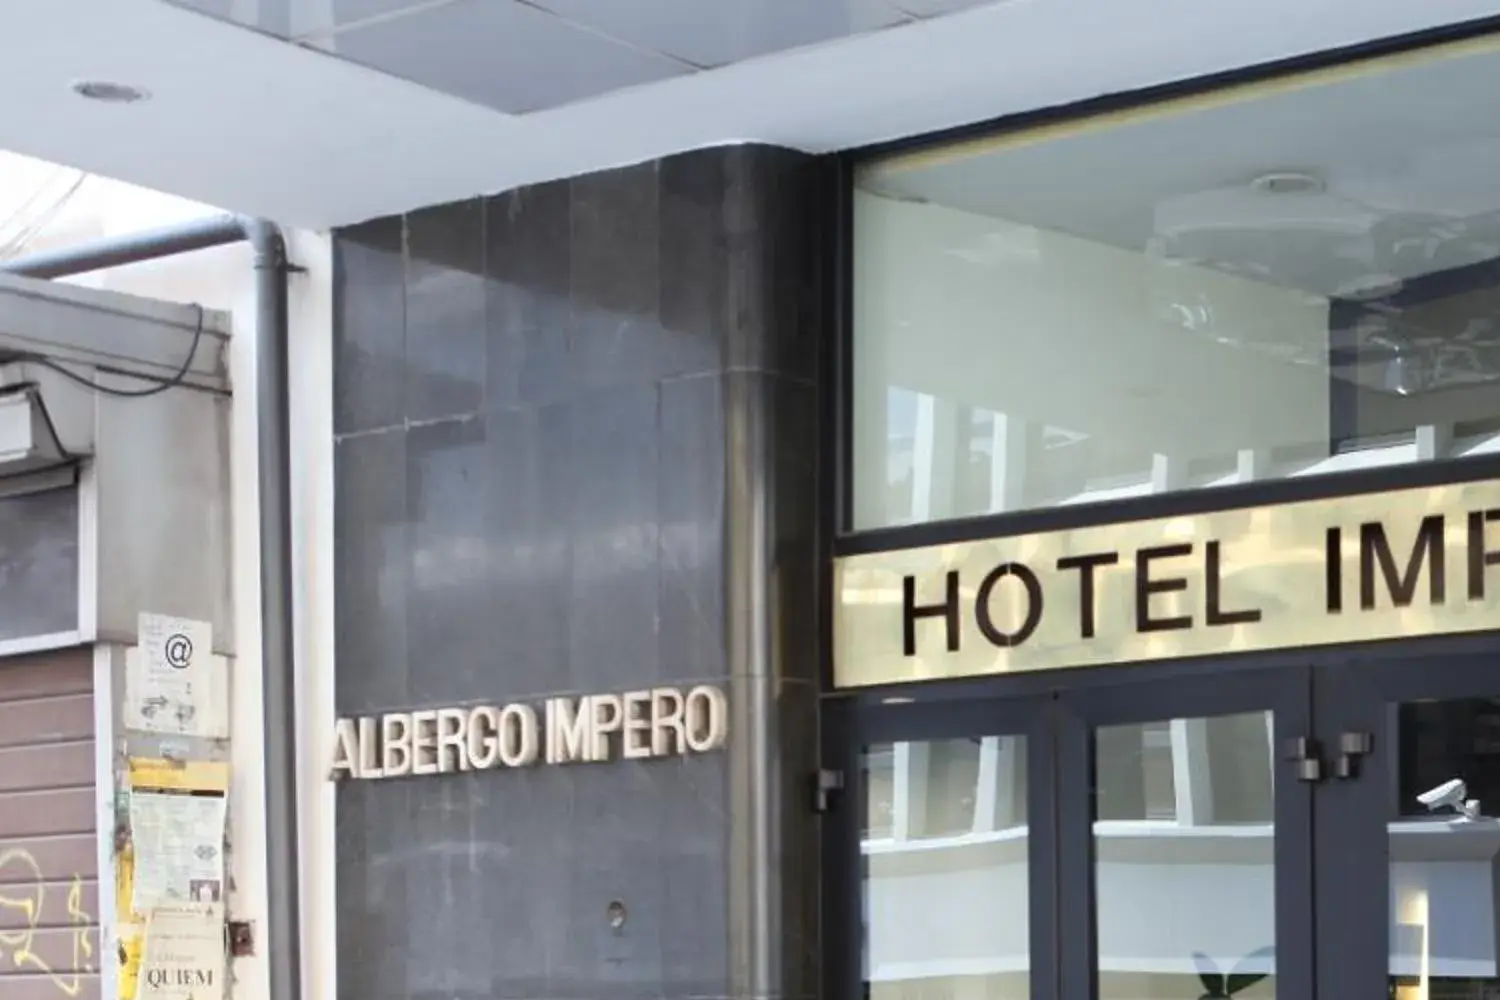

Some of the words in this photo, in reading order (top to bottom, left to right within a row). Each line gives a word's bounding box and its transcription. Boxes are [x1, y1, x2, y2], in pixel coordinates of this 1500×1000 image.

[902, 541, 1262, 657] HOTEL
[329, 702, 539, 782] ALBERGO
[545, 684, 729, 765] IMPERO
